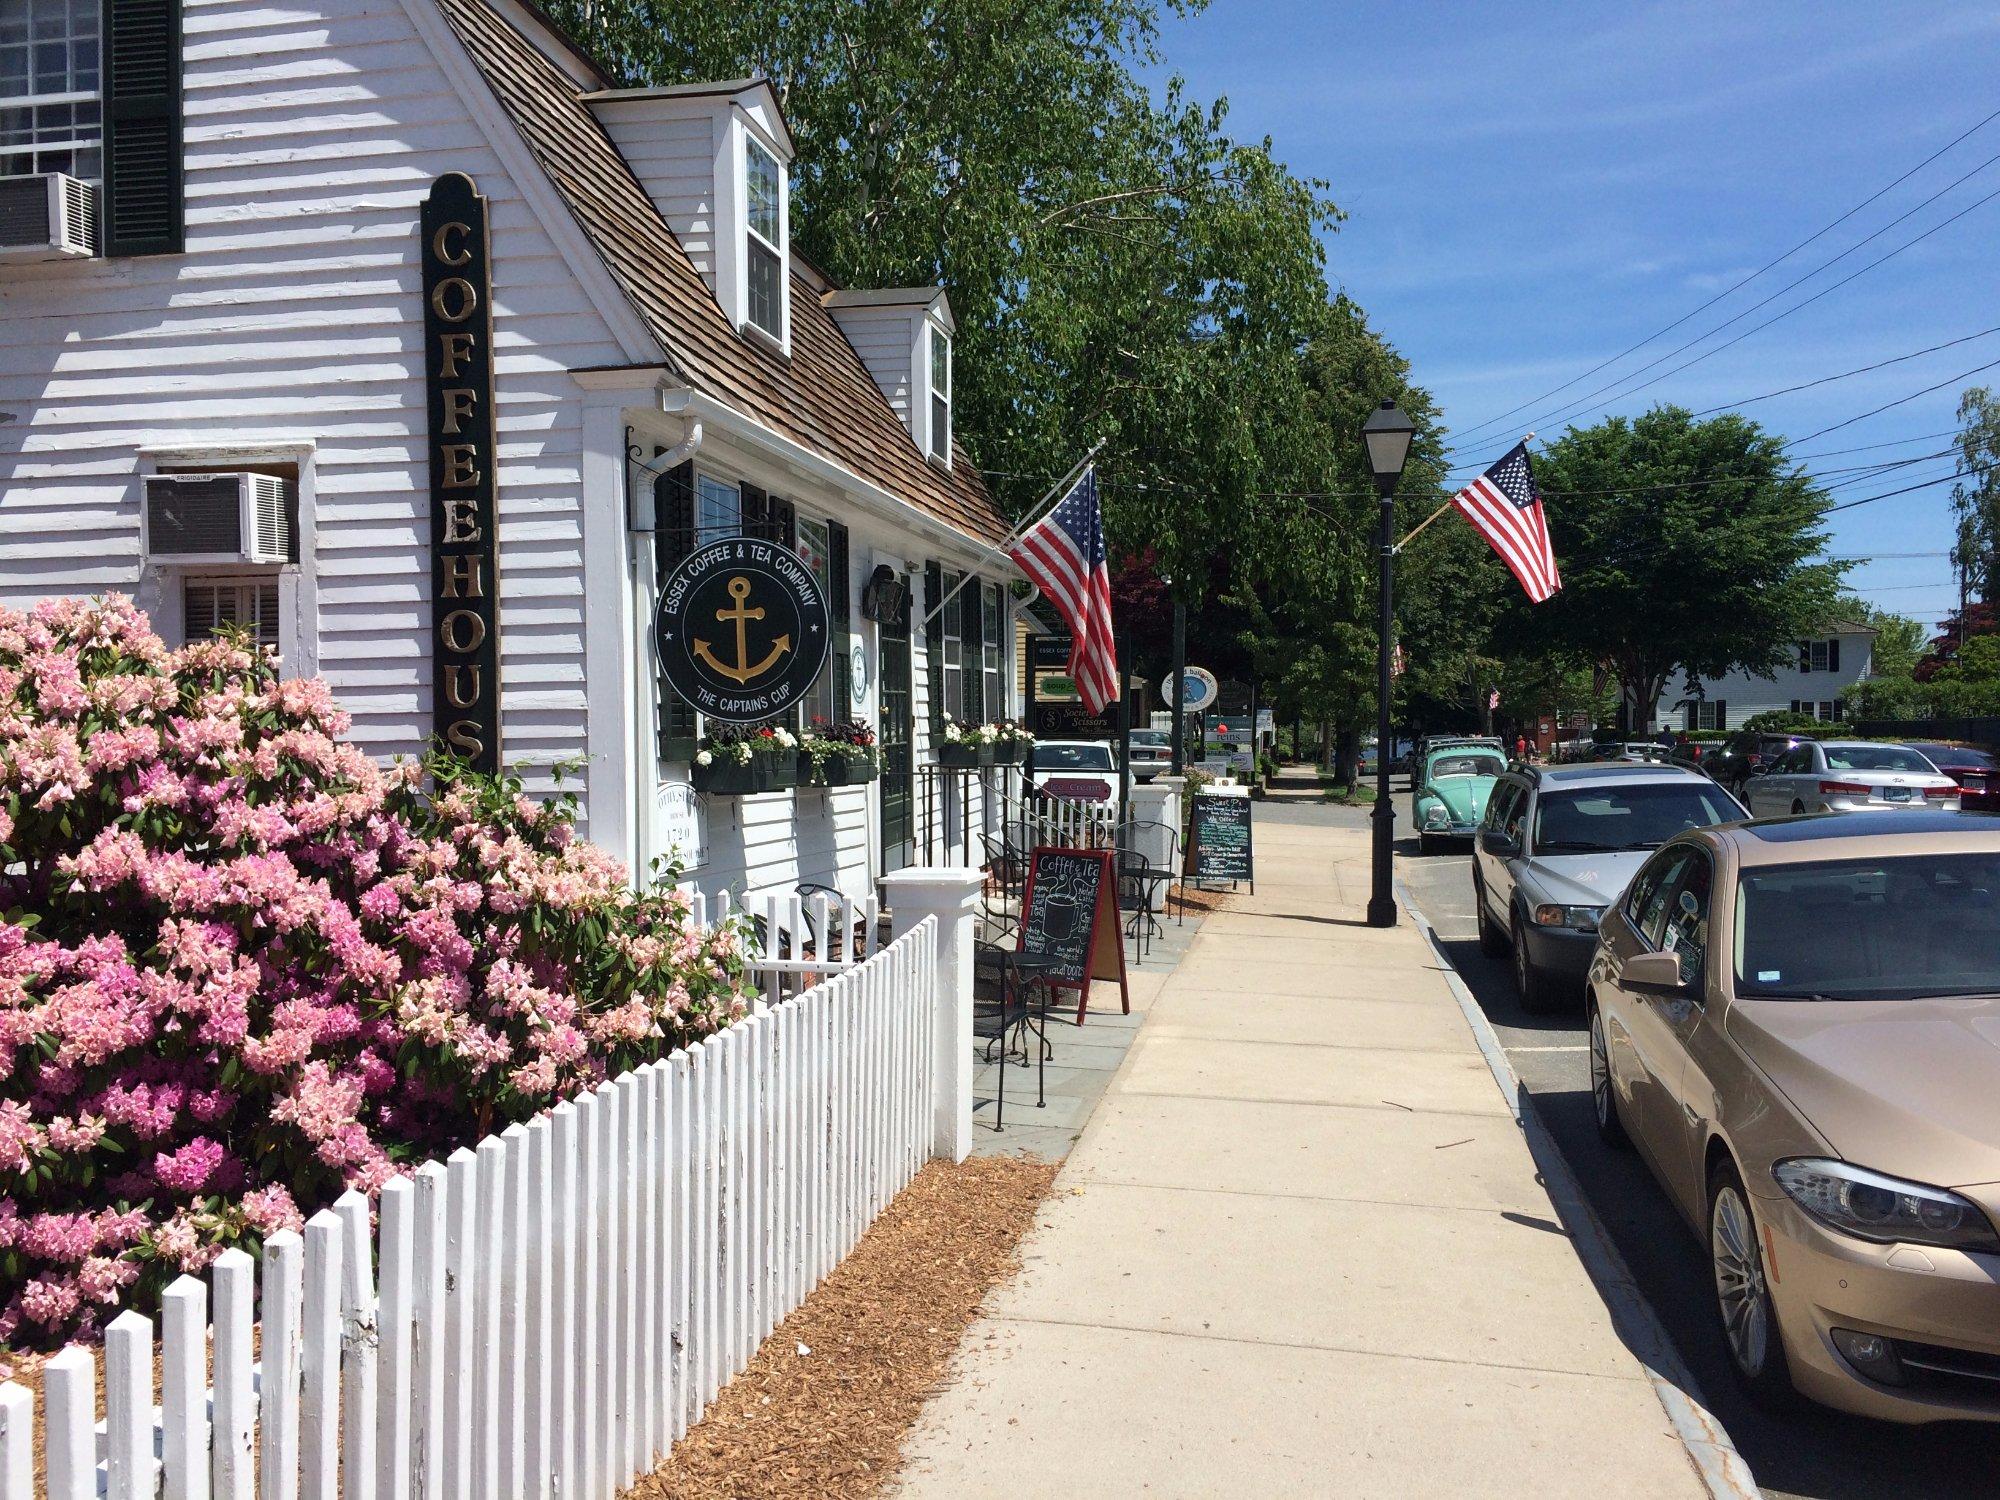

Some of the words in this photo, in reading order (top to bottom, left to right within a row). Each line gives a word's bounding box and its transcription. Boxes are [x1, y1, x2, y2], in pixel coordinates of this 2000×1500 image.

[664, 574, 691, 615] ESSEX
[688, 545, 731, 576] COFFEE
[736, 543, 744, 558] &
[750, 544, 772, 564] TEA
[775, 556, 818, 607] COMPANY
[1046, 683, 1066, 691] soup
[720, 694, 769, 713] CAPTAIN'S
[1071, 716, 1108, 727] Scissors
[1216, 733, 1241, 741] reins
[1069, 783, 1101, 791] Cream
[1039, 855, 1075, 874] Coffee
[1081, 858, 1100, 877] Tea
